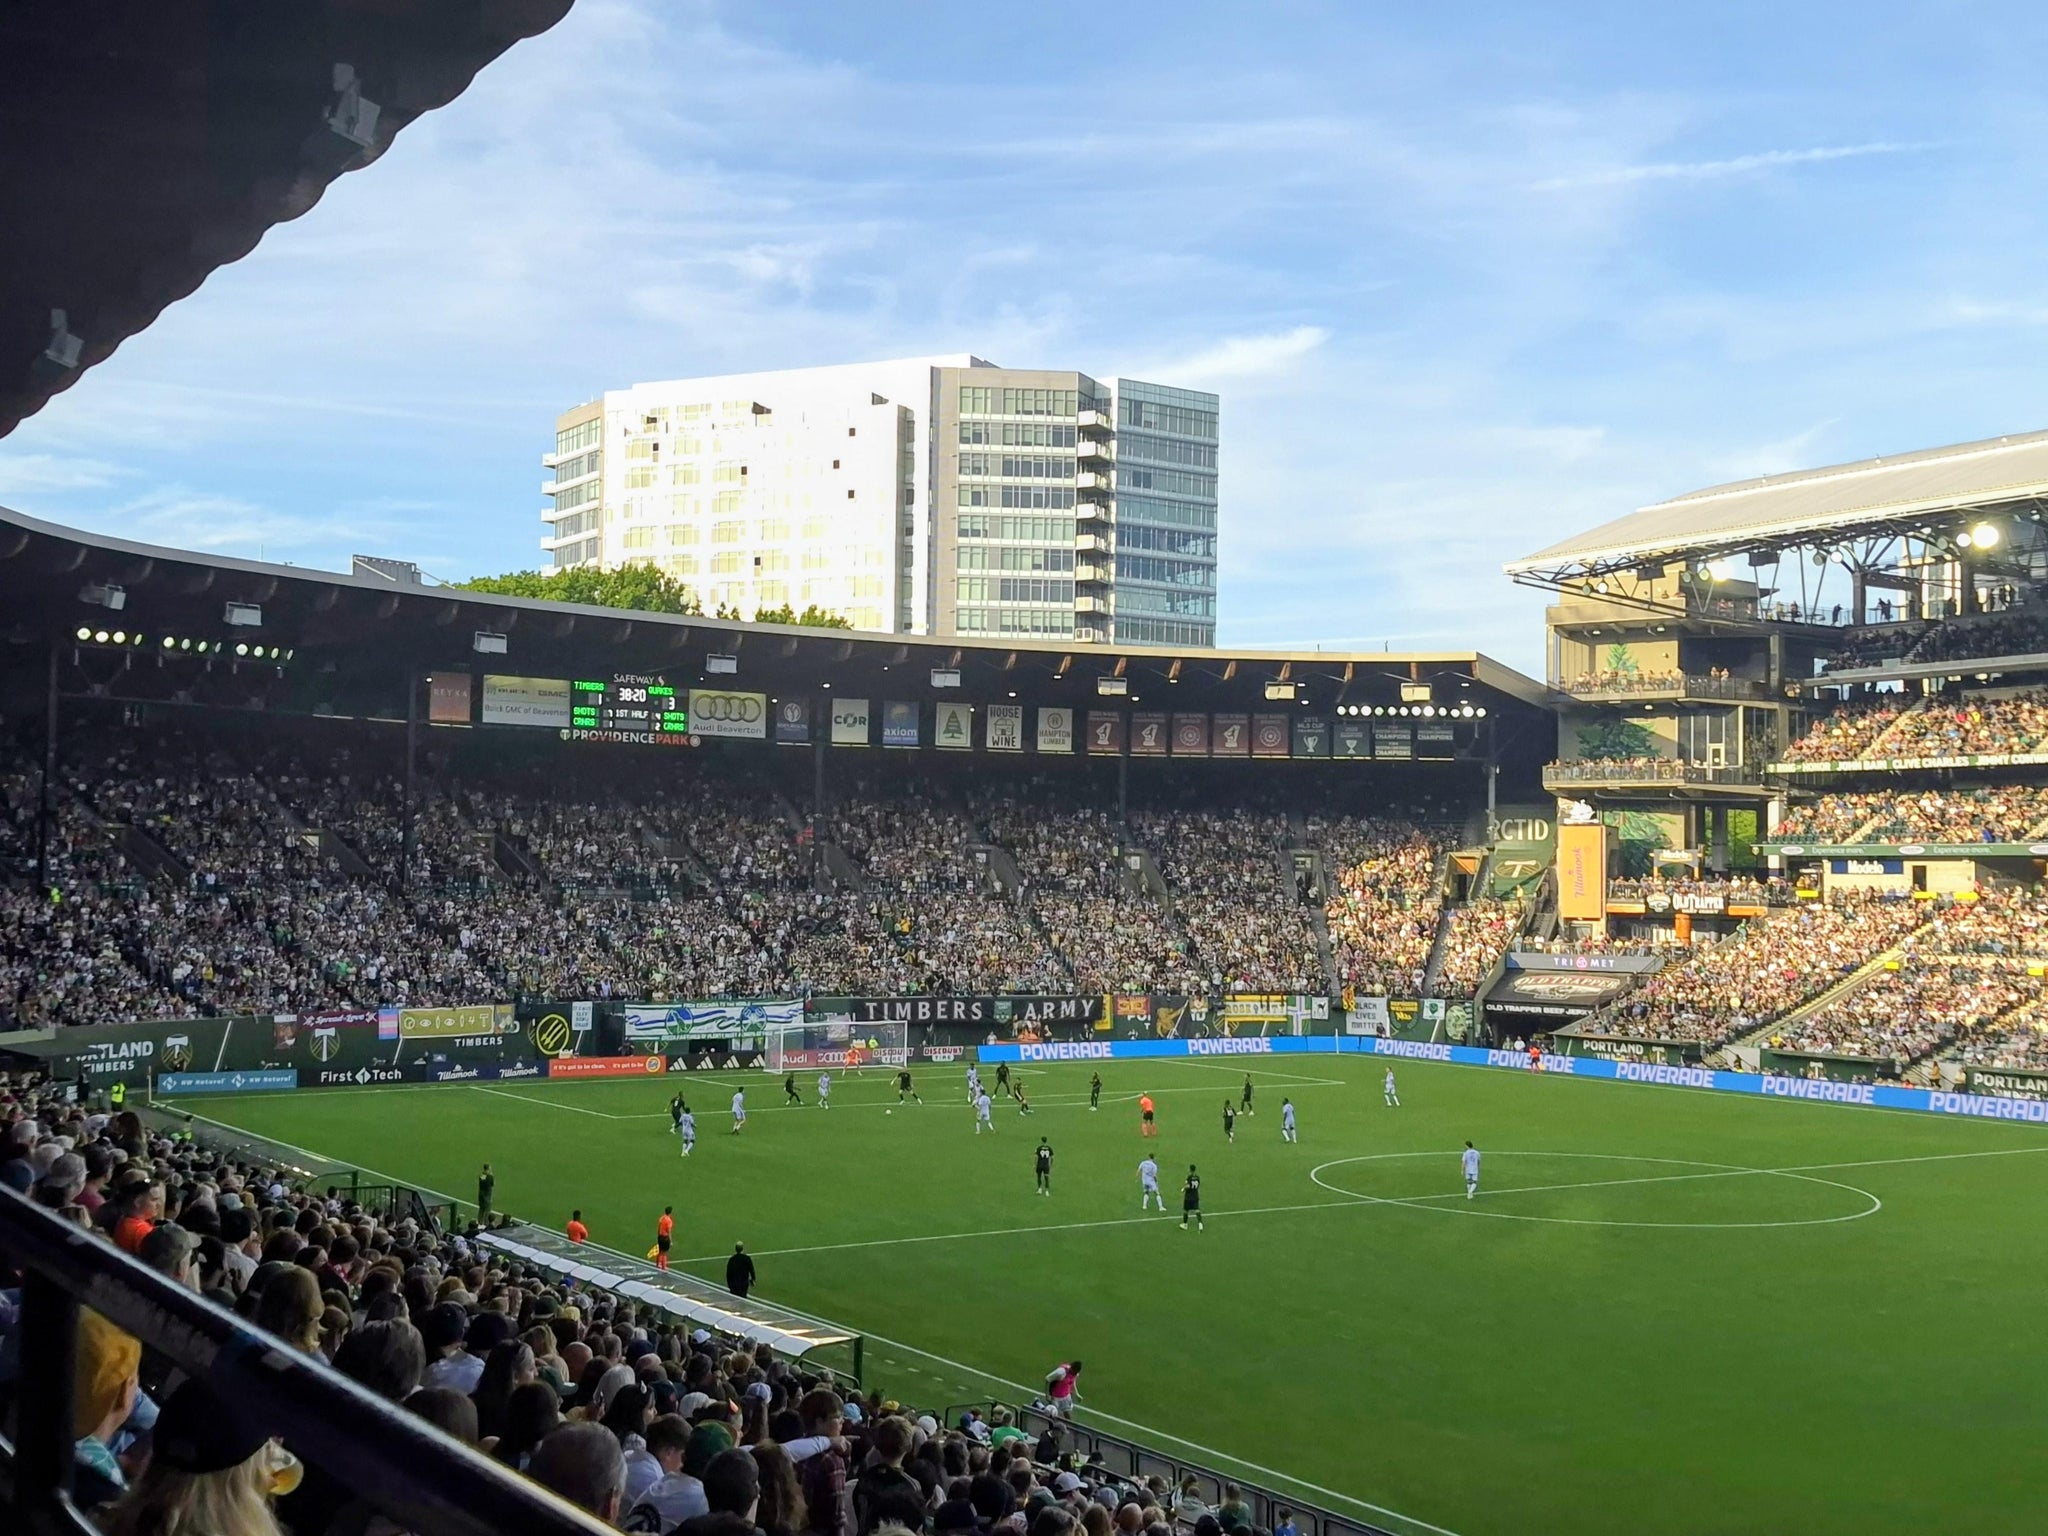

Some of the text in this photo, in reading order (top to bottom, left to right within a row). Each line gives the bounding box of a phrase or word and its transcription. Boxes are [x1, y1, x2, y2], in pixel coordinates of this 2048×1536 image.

[614, 673, 654, 685] SAFEWAY
[574, 681, 604, 691] TIMBERS
[648, 686, 673, 695] QUAKES
[538, 690, 569, 698] GMC
[598, 693, 602, 705] 1
[619, 688, 647, 702] 38:20
[668, 697, 675, 710] 3
[505, 705, 521, 714] GMC
[524, 705, 531, 714] of
[533, 708, 569, 717] Beaverton
[573, 707, 595, 716] SHOTS
[616, 709, 649, 718] 1ST HALF
[664, 712, 684, 721] SHOTS
[989, 706, 1020, 719] HOUSE
[693, 724, 761, 734] Audi Beaverton
[883, 726, 917, 737] axiom
[1039, 730, 1071, 738] HAMPTON
[992, 736, 1016, 747] WINE
[1922, 757, 1969, 768] CHARLES
[1811, 847, 1845, 855] Experience
[1934, 846, 1969, 854] Experience
[1847, 860, 1884, 874] Modelo
[1574, 848, 1585, 898] Tillamook
[1687, 893, 1724, 912] TRAPPER
[1554, 957, 1615, 968] TRI MET
[1517, 976, 1619, 988] OLD TRAPPER
[865, 1001, 983, 1020] TIMBERS
[1024, 999, 1094, 1020] ARMY
[1260, 1003, 1285, 1014] CTY
[1355, 1002, 1377, 1010] BLACK
[1504, 1005, 1542, 1013] TRAPPER
[1355, 1012, 1377, 1020] LIVES
[454, 1037, 503, 1047] TIMBERS
[1188, 1037, 1272, 1054] POWERADE
[1583, 1040, 1644, 1055] PORTLAND
[924, 1047, 963, 1056] DISCOUNT
[1020, 1042, 1113, 1060] POWERADE
[1375, 1038, 1453, 1060] POWERADE
[783, 1054, 807, 1063] Audi
[321, 1069, 402, 1083] First Tech
[437, 1067, 478, 1081] Tillamook
[499, 1066, 539, 1079] Tillamook
[1616, 1062, 1716, 1088] POWERADE
[196, 1077, 225, 1086] Natural
[264, 1075, 292, 1083] Natural
[1761, 1075, 1876, 1105] POWERADE
[1929, 1092, 2048, 1122] POWERAD
